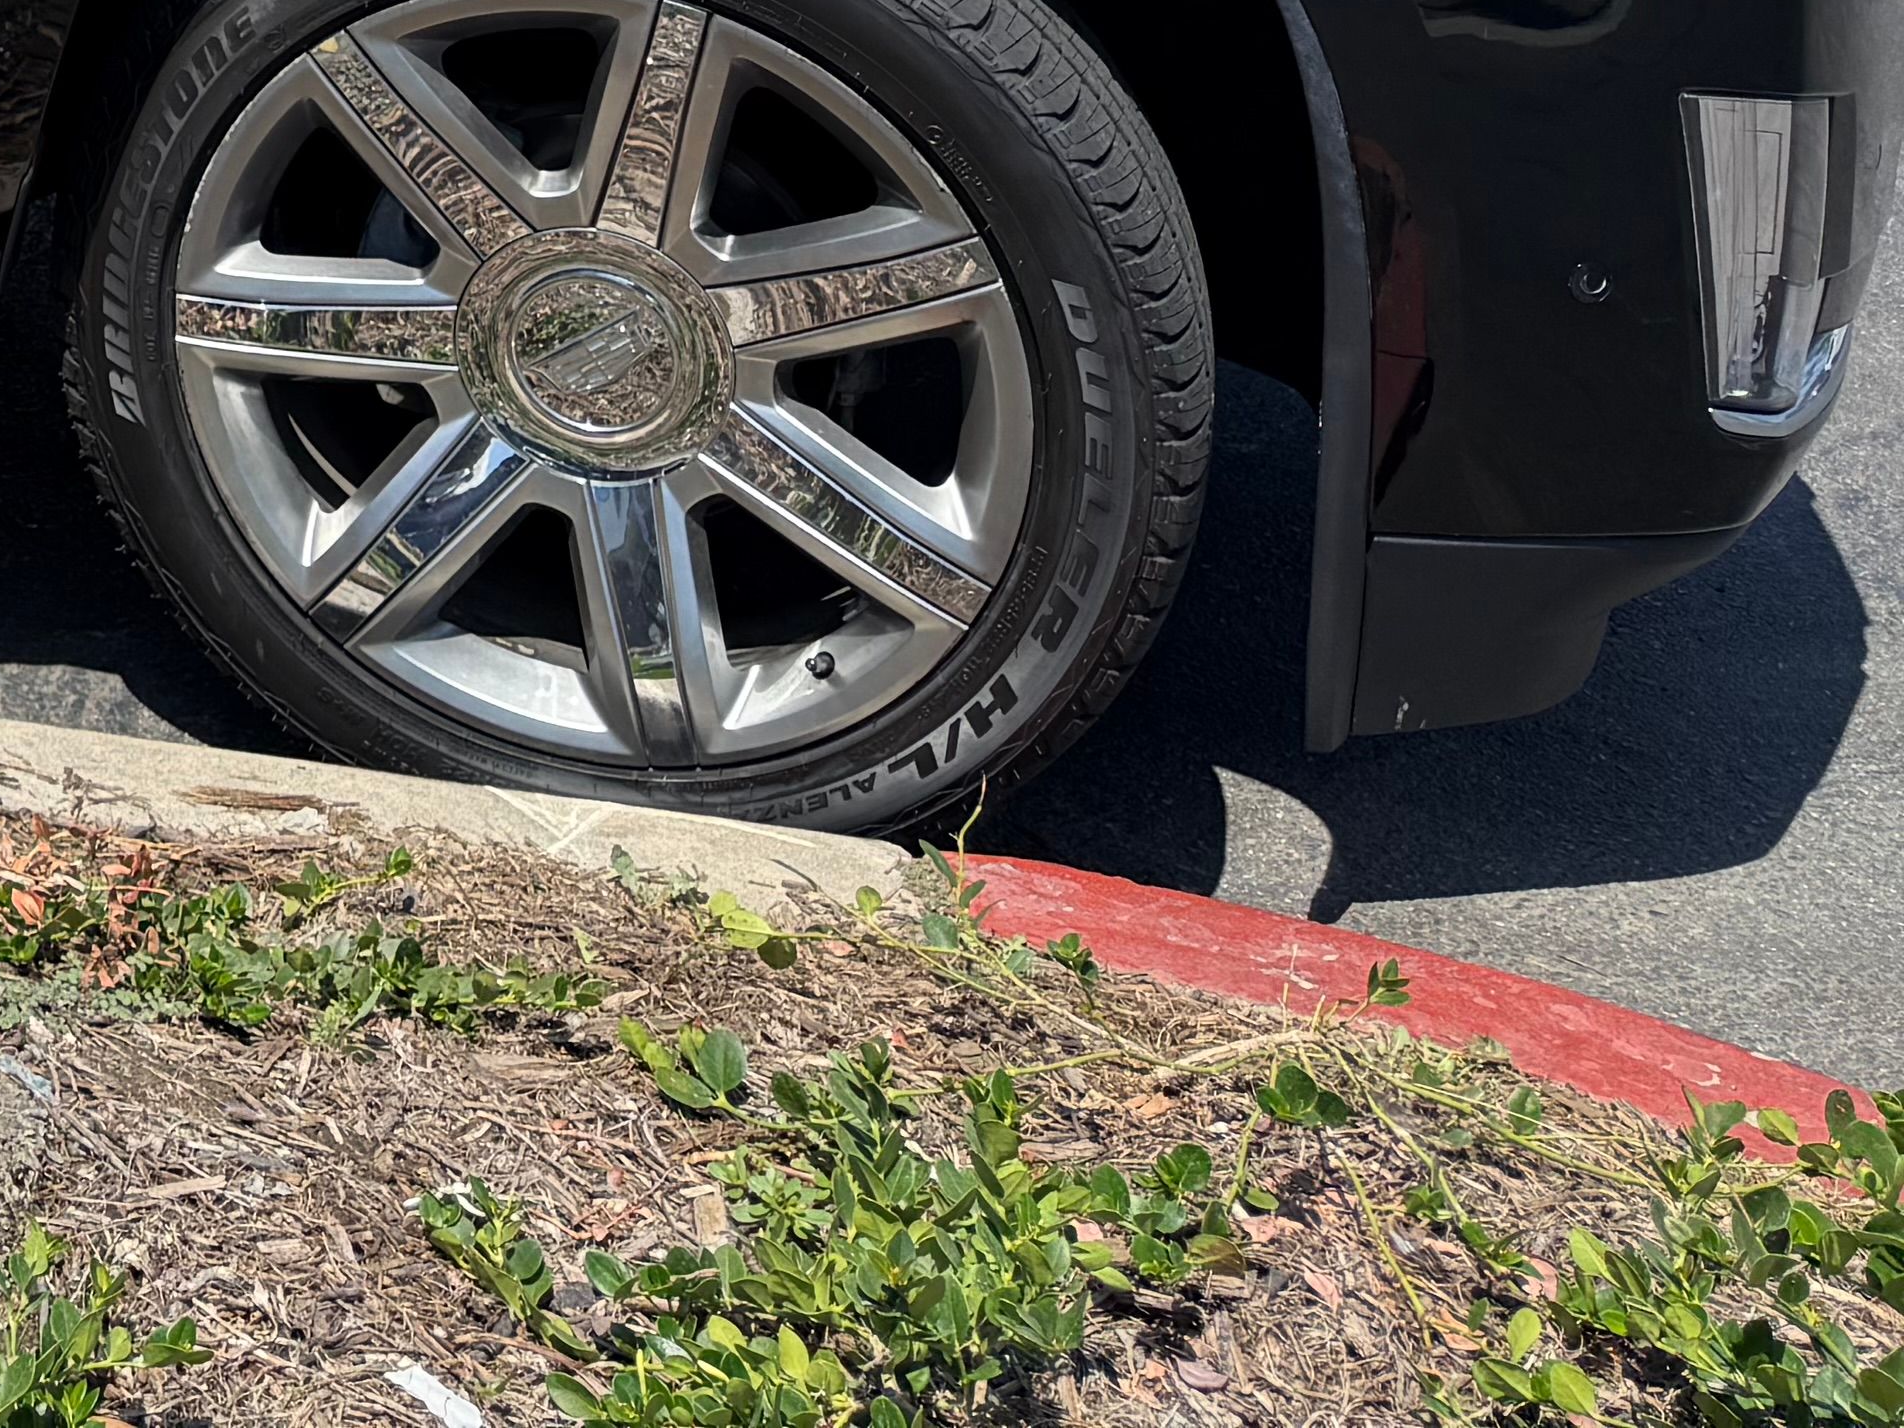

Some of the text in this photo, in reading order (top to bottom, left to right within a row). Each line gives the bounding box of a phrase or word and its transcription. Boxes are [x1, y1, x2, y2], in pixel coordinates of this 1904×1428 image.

[102, 5, 257, 428] BRIDGESTONE
[1030, 278, 1114, 654] DUELER
[888, 673, 1020, 781] H/L
